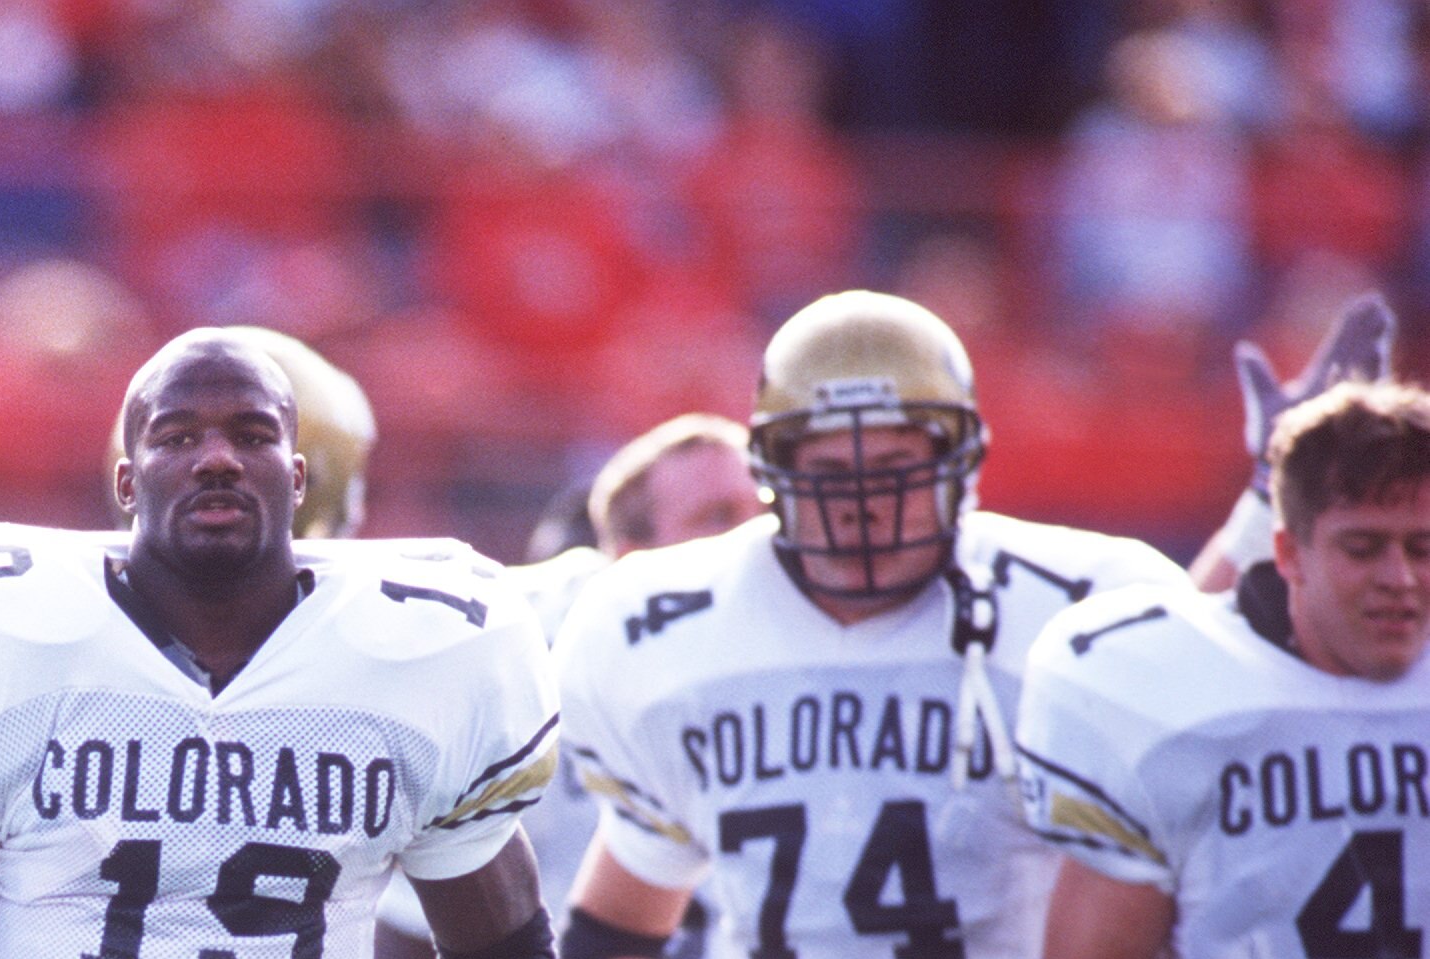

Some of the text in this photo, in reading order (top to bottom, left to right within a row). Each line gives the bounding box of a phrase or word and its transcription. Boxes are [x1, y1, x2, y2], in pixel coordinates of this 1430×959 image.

[624, 588, 714, 646] 4
[1070, 604, 1168, 656] 1
[32, 736, 395, 839] COLORADO
[1220, 742, 1430, 837] COLOR
